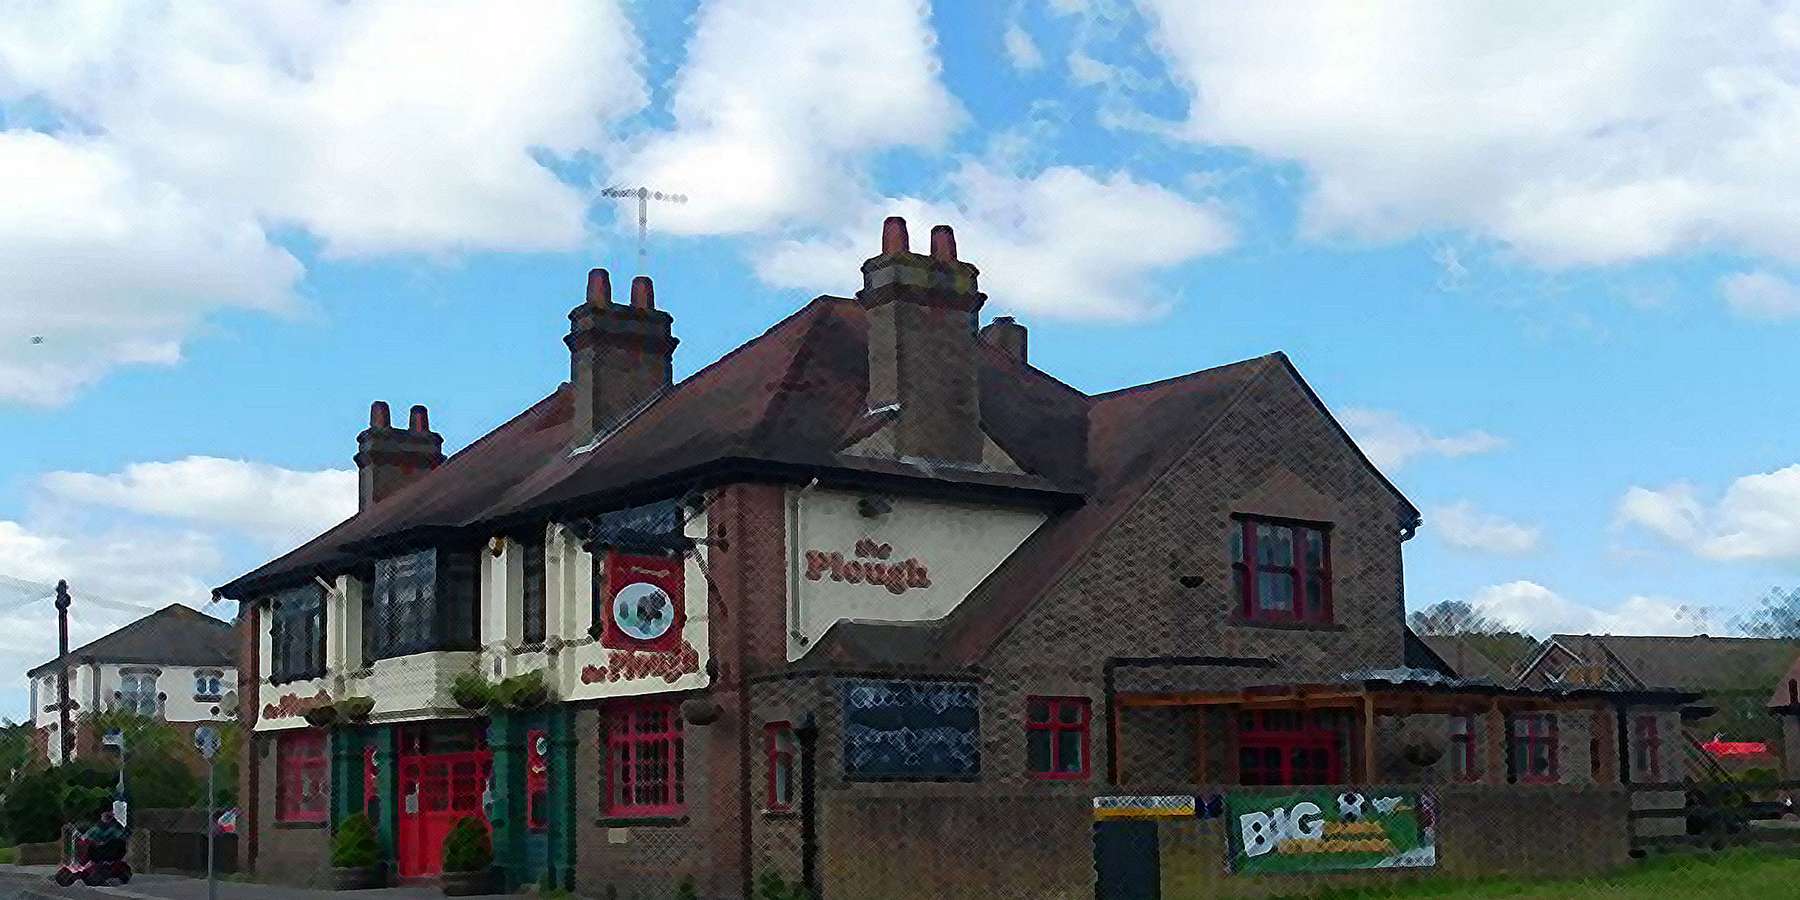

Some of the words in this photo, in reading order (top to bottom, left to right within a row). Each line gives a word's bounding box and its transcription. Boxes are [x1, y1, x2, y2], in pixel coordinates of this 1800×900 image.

[804, 549, 932, 595] Plough
[855, 538, 892, 560] the
[1240, 801, 1324, 857] BIG
